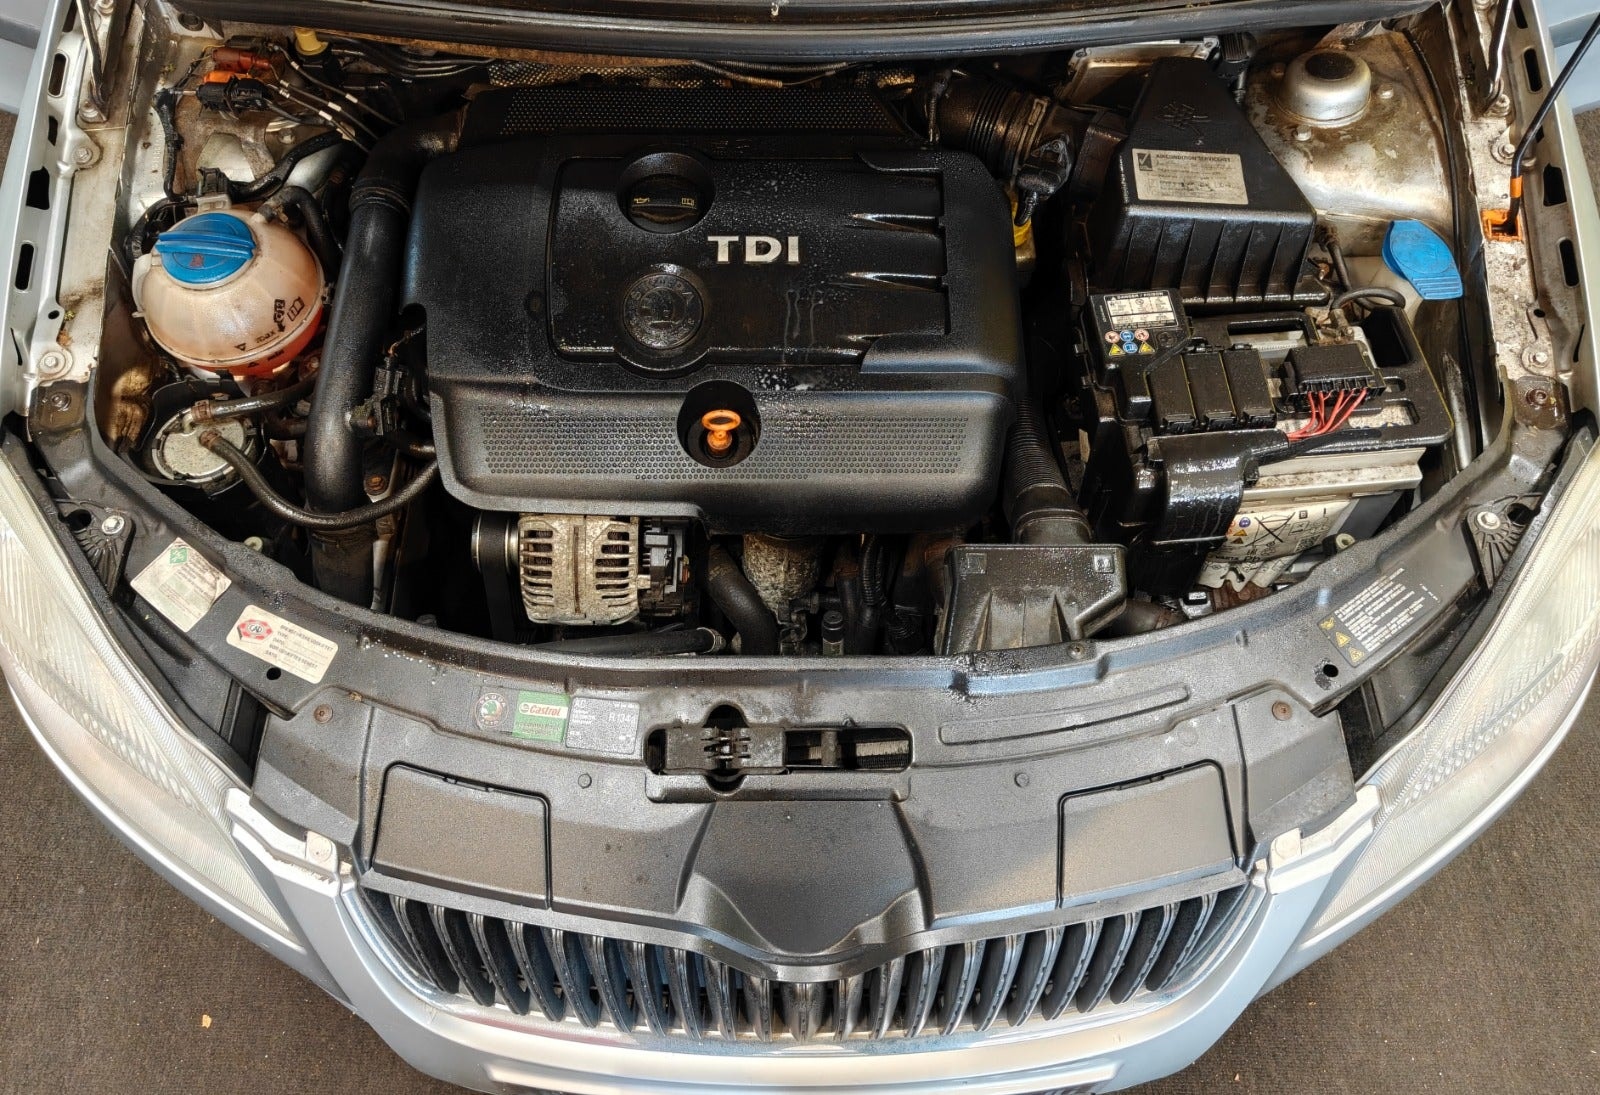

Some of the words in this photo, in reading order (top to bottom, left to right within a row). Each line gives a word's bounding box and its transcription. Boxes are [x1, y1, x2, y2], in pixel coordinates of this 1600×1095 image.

[707, 235, 800, 264] TDI
[255, 330, 276, 344] max
[529, 704, 561, 717] Castrol
